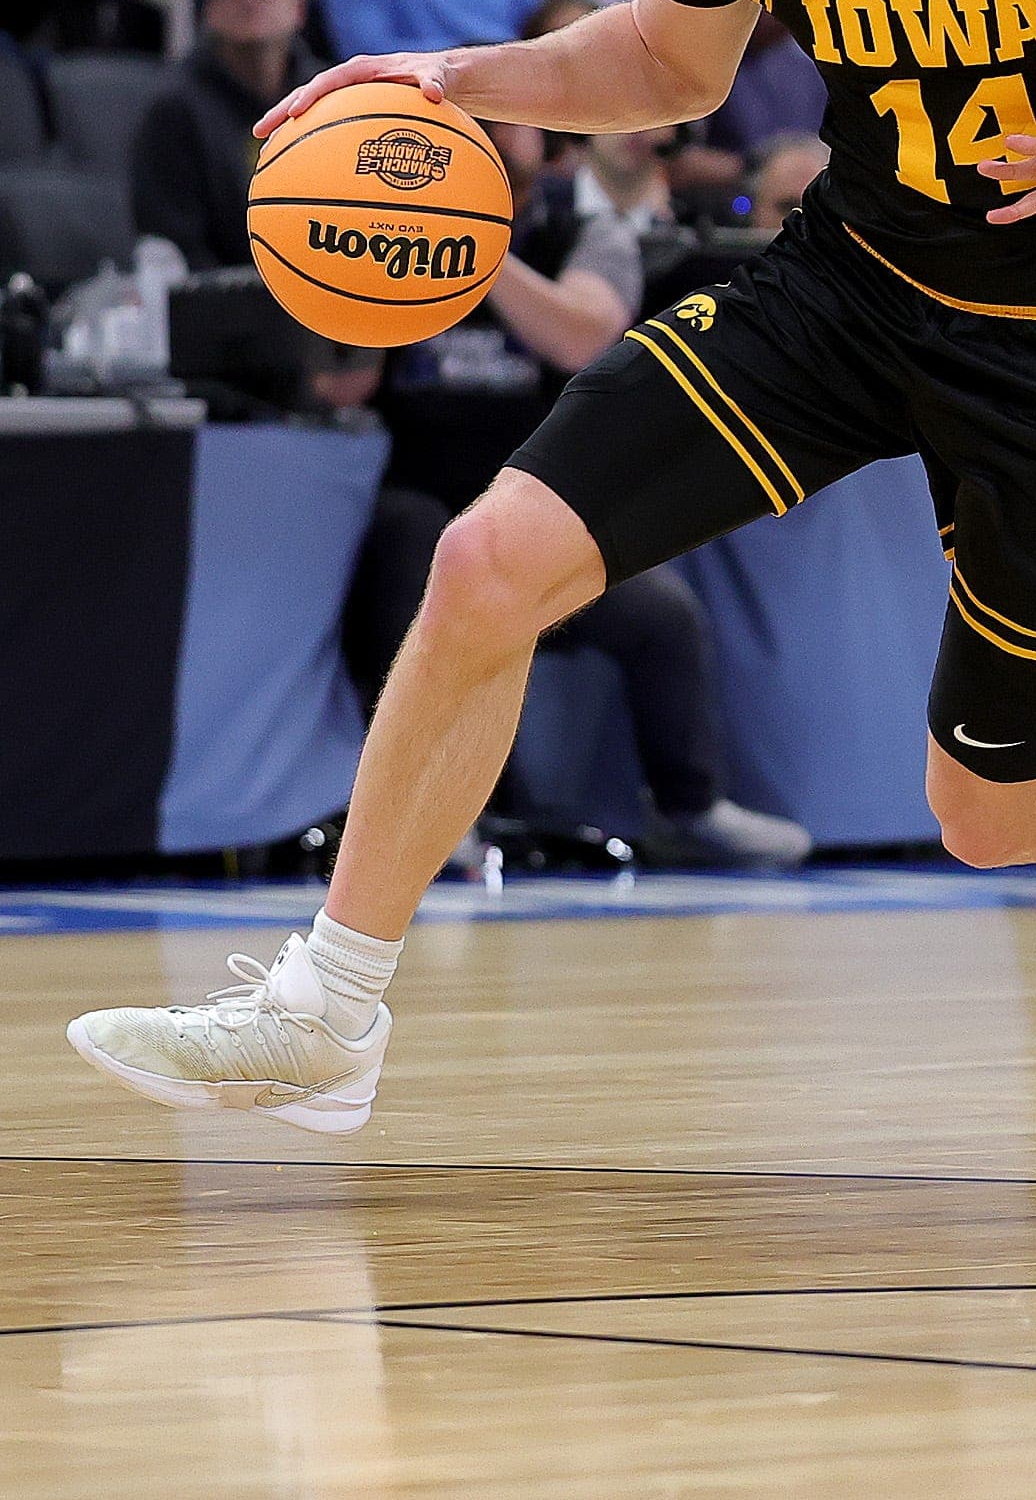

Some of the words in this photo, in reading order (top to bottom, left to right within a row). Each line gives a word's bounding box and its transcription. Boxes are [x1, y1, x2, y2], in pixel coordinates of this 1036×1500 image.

[359, 143, 427, 161] MADNESS
[381, 157, 432, 177] MARCH
[368, 221, 395, 232] NXT
[398, 224, 424, 234] EVO
[307, 219, 477, 280] Wilson
